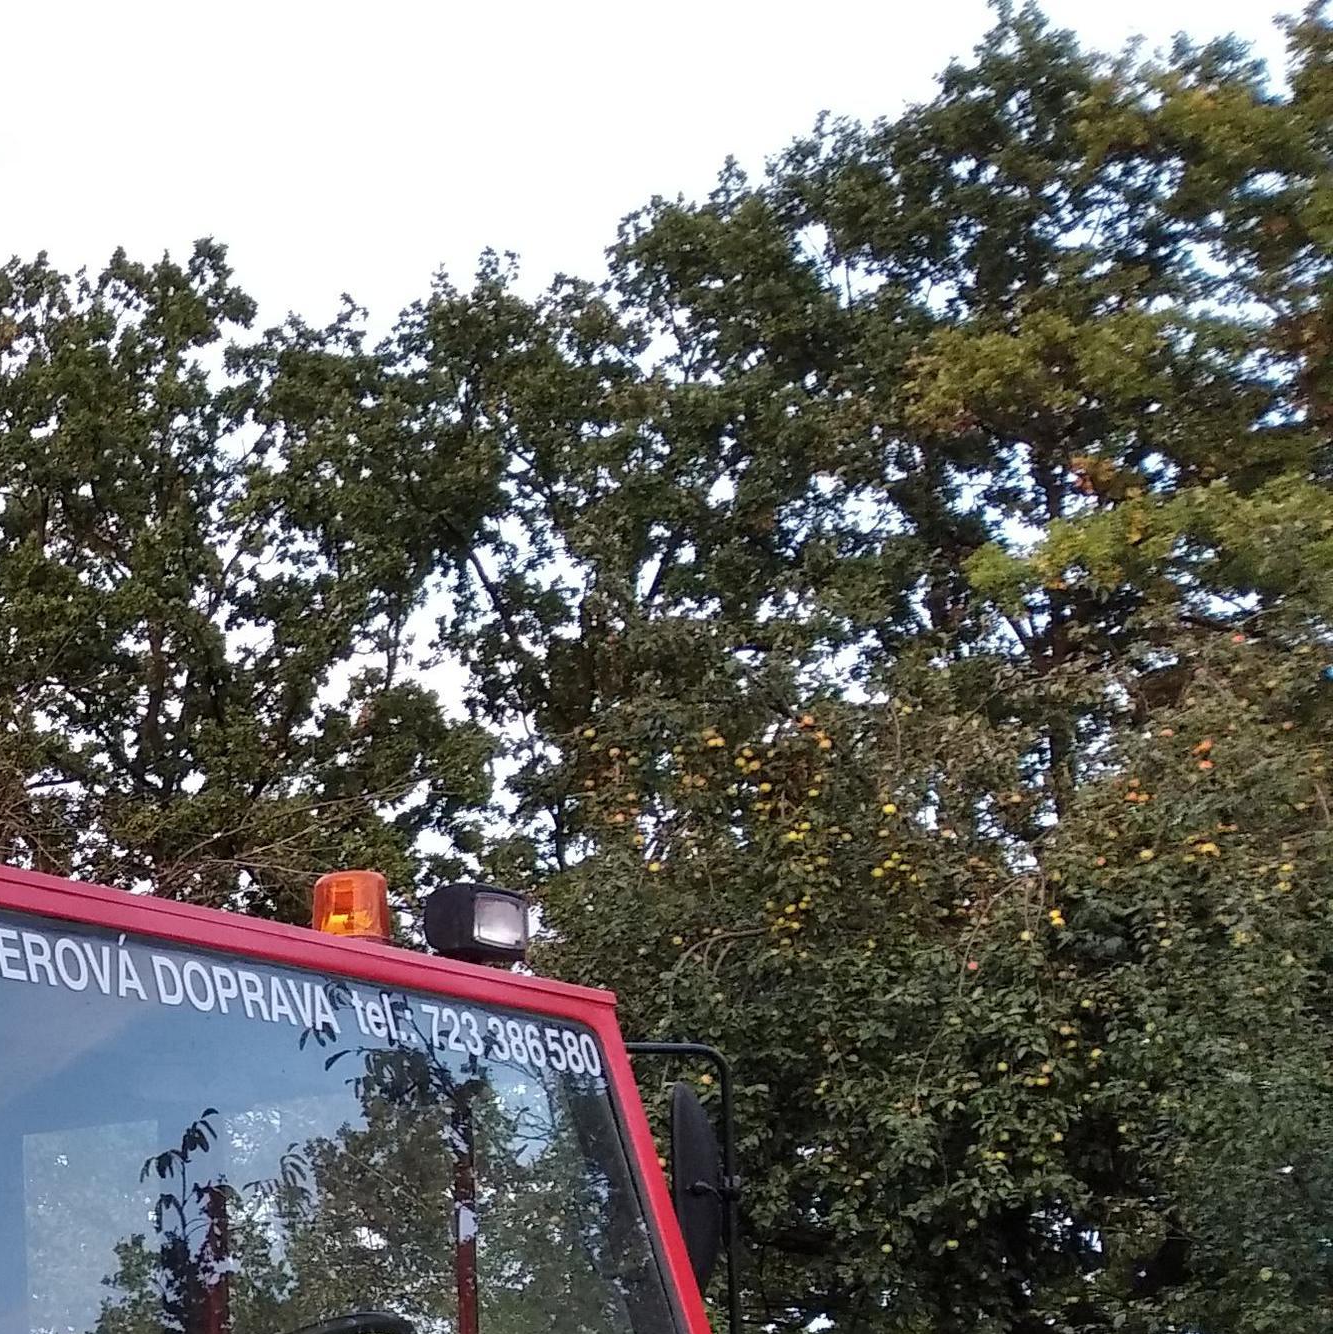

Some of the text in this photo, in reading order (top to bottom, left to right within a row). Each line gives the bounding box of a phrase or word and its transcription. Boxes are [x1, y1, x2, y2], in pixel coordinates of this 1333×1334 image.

[150, 954, 342, 1035] DOPRAVA
[351, 989, 418, 1044] tel.:
[420, 1002, 484, 1057] 723
